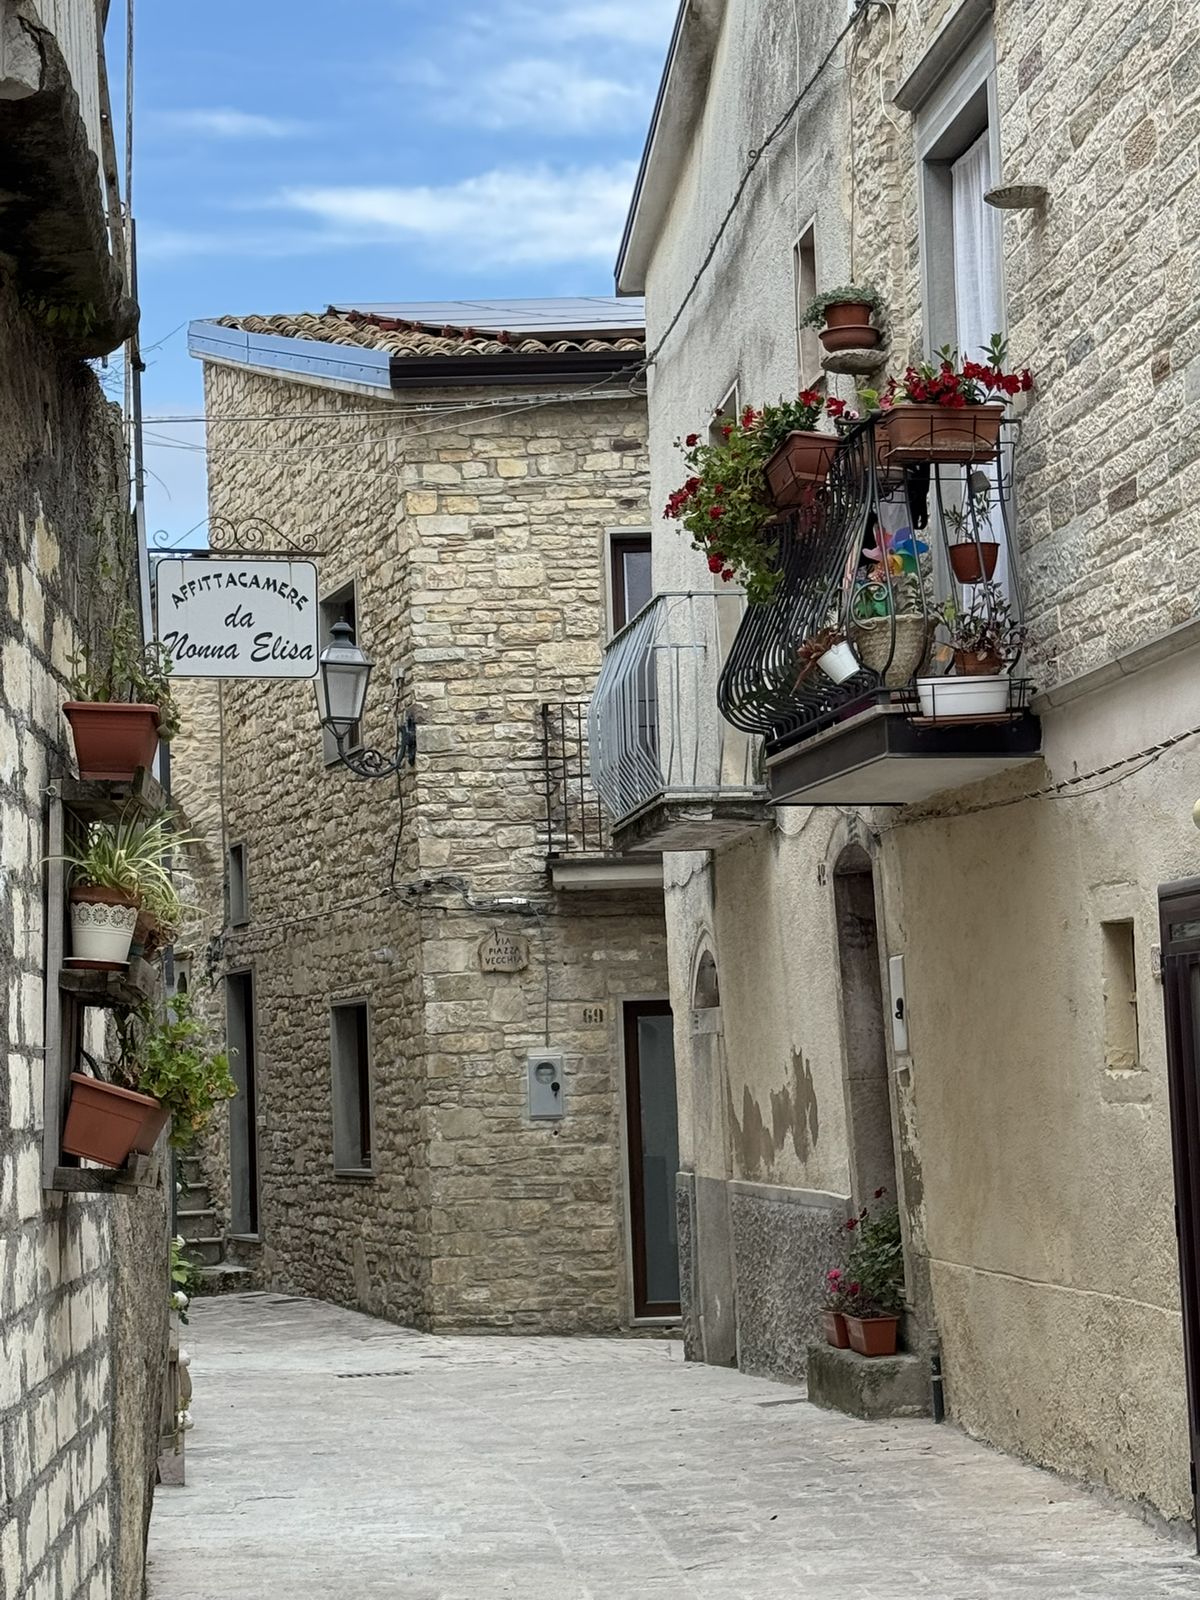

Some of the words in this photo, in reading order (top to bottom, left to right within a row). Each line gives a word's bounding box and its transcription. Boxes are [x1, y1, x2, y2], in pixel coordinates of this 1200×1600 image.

[171, 572, 309, 612] AFFITTACAMERE
[224, 604, 256, 628] da
[163, 631, 240, 660] Nonna
[250, 632, 315, 662] Elisa
[495, 937, 511, 946] VIA
[488, 946, 520, 955] PIAZZA
[485, 956, 524, 965] VECCHIA
